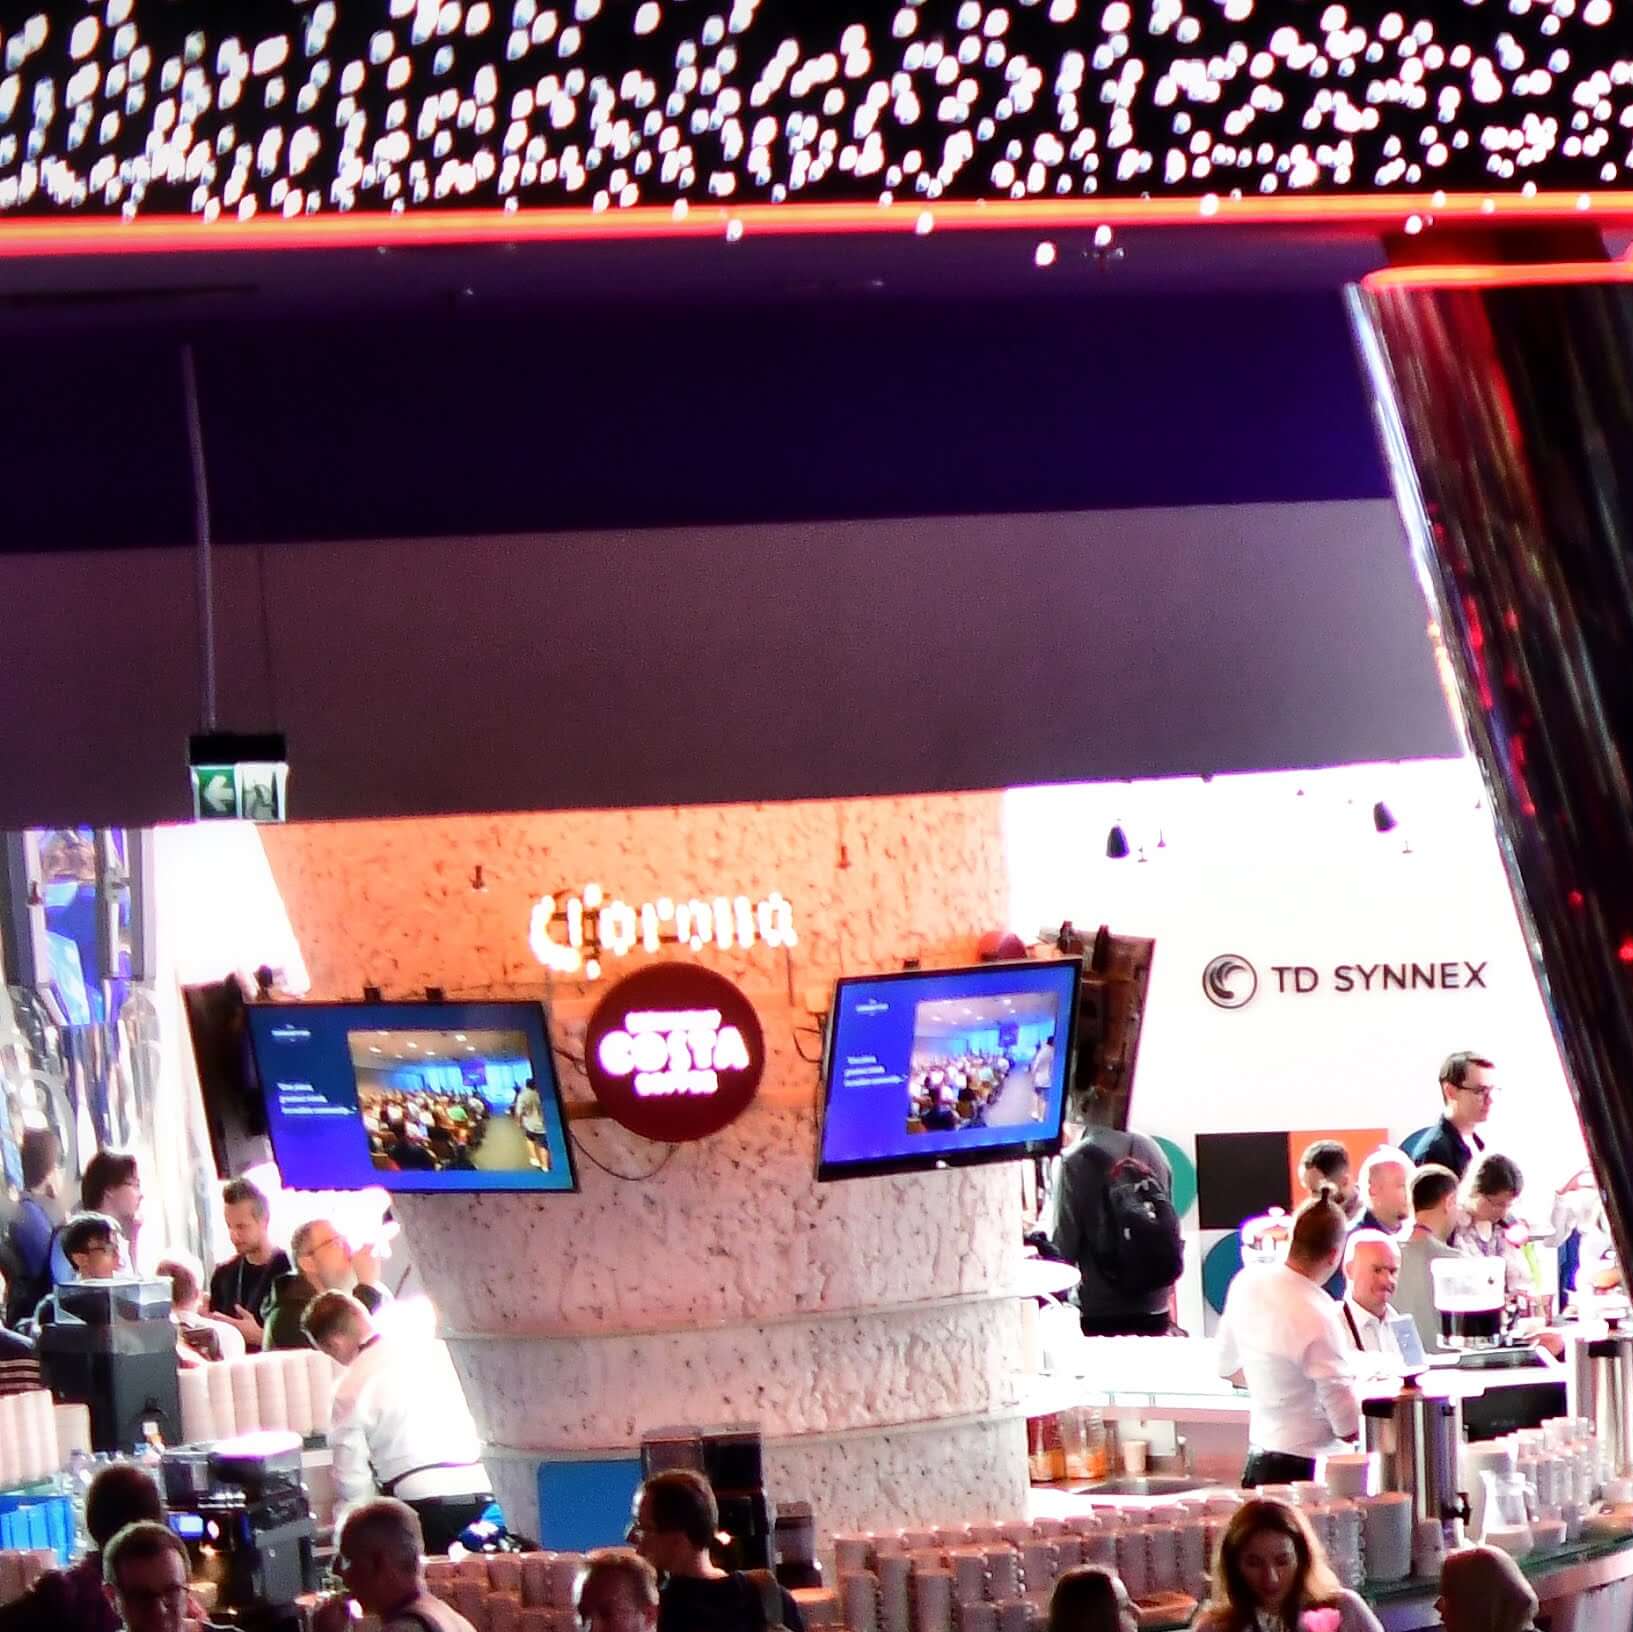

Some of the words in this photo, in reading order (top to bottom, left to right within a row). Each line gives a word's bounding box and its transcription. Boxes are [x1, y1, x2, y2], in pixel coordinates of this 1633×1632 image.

[529, 884, 798, 980] Corona
[1271, 966, 1319, 993] TD
[1334, 961, 1488, 993] SYNNEX
[599, 1025, 750, 1076] COSTA
